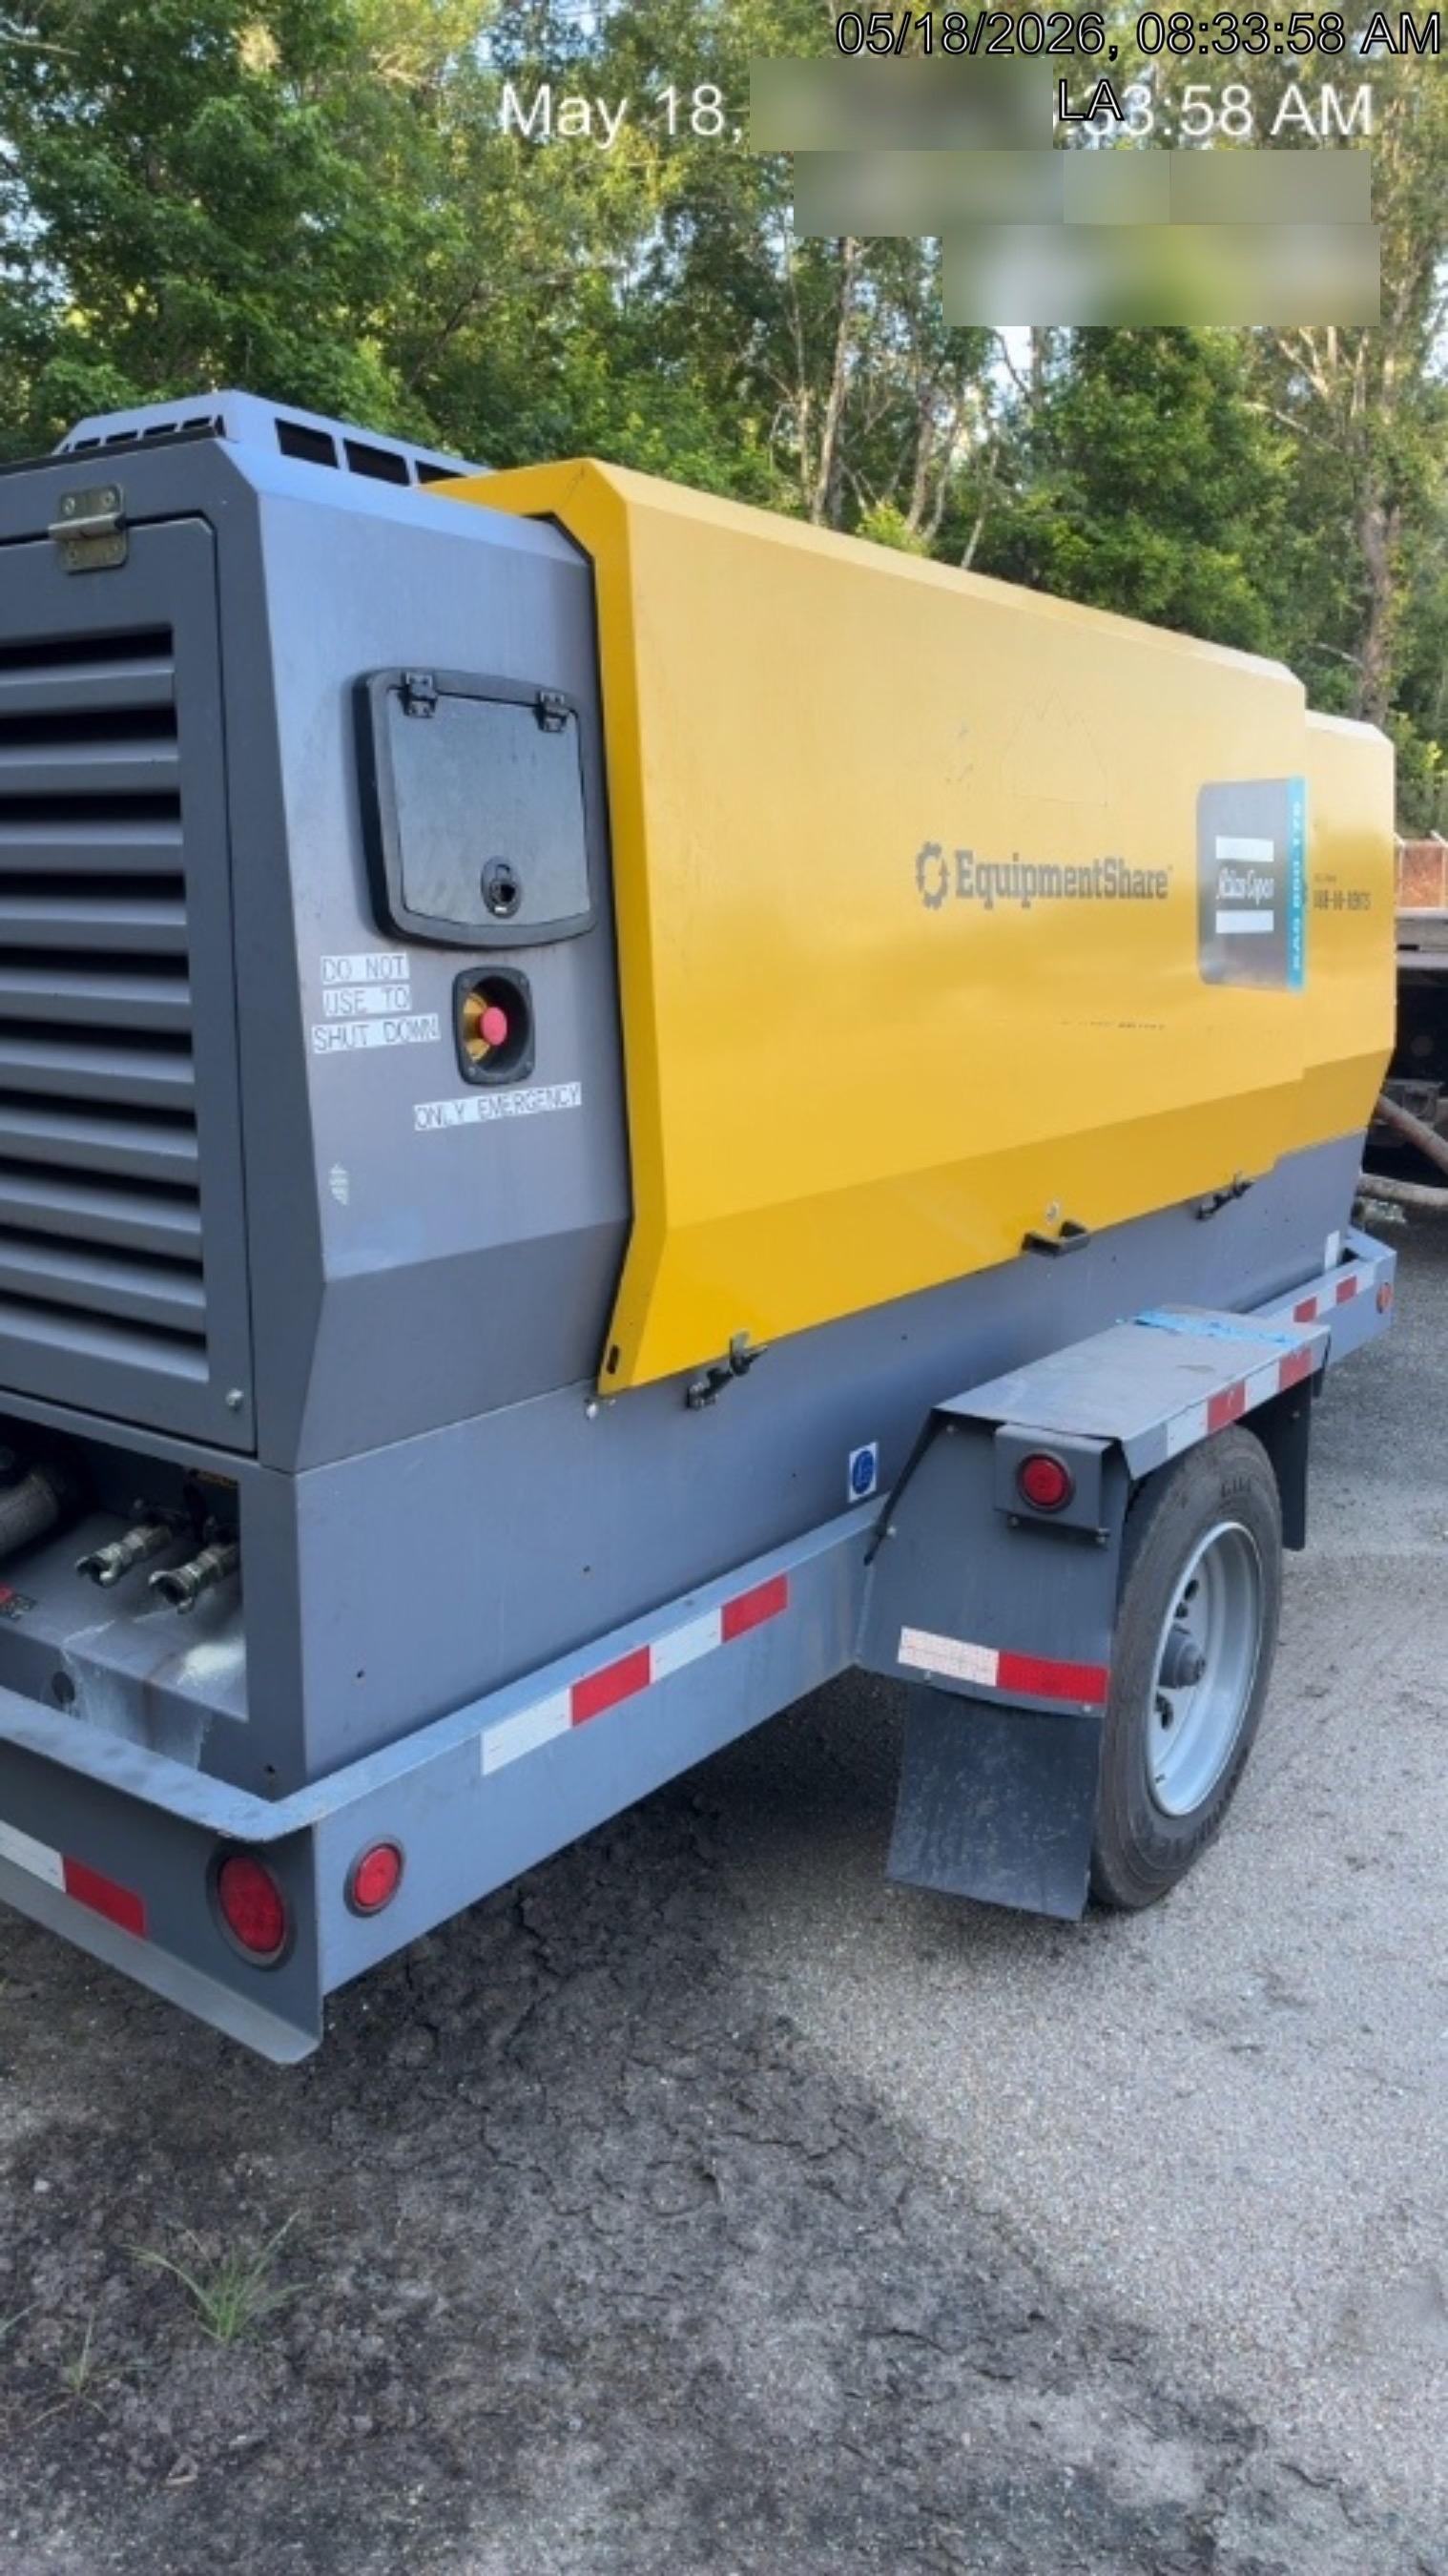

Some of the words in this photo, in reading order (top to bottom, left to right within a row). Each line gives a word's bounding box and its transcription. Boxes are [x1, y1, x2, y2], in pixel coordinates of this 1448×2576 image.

[955, 849, 1169, 909] EquipmentShare
[322, 957, 352, 982] DO
[366, 954, 404, 978] NOT
[324, 988, 365, 1015] USE
[383, 987, 407, 1009] TO
[313, 1024, 369, 1050] SHUT
[383, 1016, 437, 1044] DOWN
[478, 1084, 581, 1119] EMERGENCY
